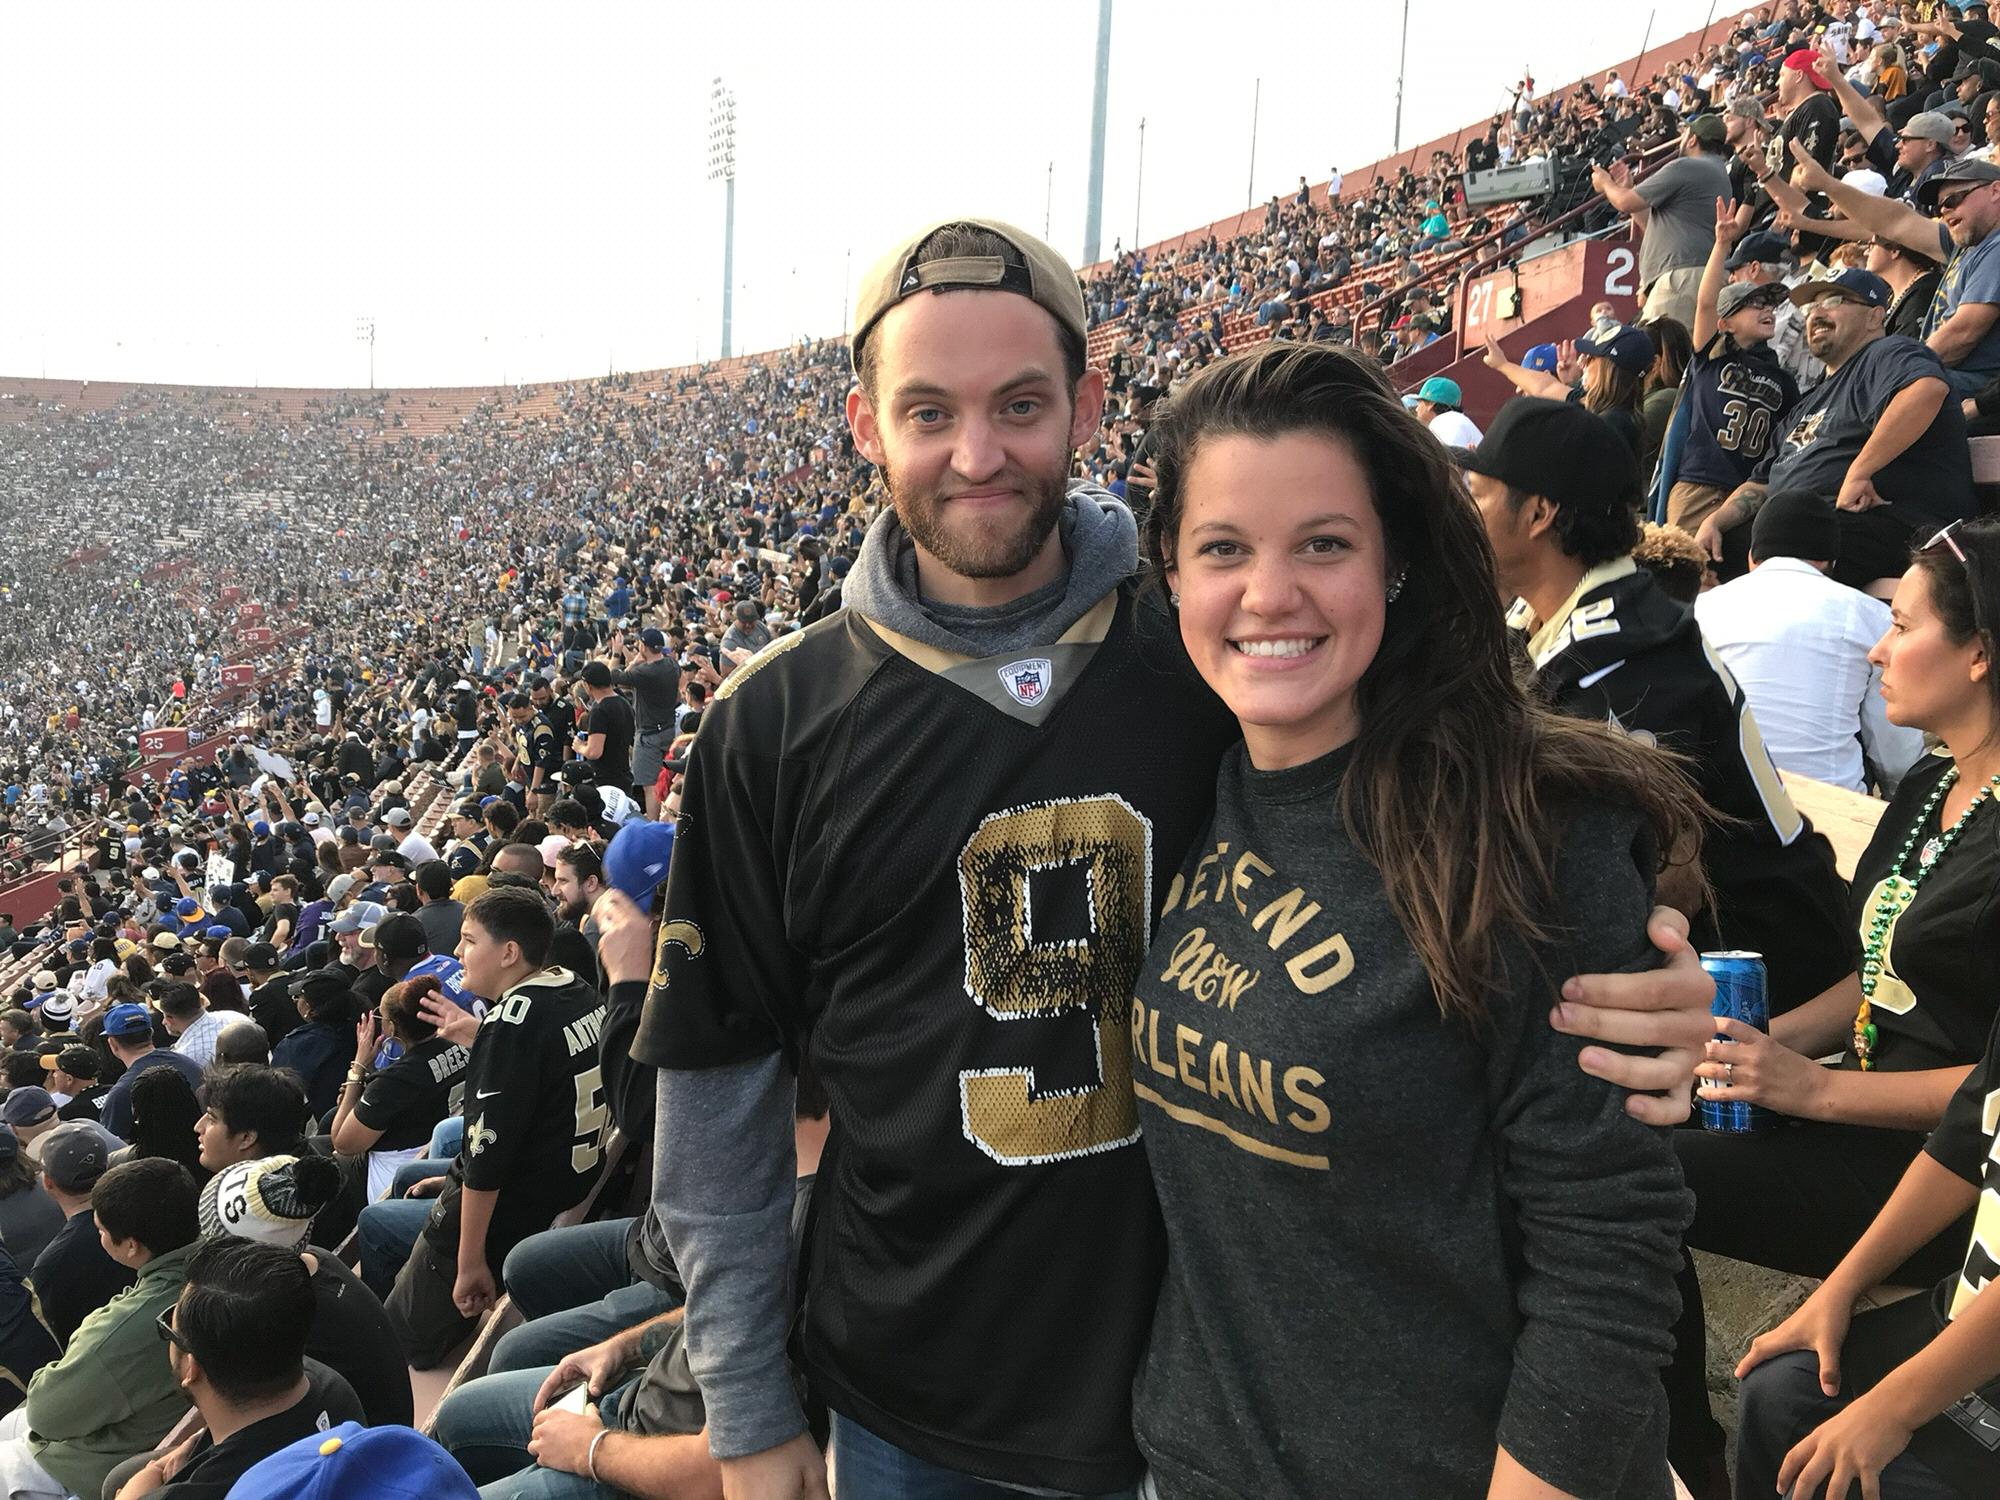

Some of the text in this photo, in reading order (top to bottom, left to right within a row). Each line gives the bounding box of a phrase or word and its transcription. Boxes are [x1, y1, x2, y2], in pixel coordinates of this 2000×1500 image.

[1605, 248, 1635, 296] 2
[1468, 280, 1494, 326] 27
[1717, 400, 1770, 458] 30
[247, 632, 259, 640] 23
[225, 671, 239, 681] 24
[1003, 662, 1047, 678] EQUIPMENT
[1019, 683, 1040, 697] NFL
[144, 738, 164, 750] 25
[958, 791, 1153, 1166] 9
[562, 1004, 608, 1057] ANTHO
[1131, 997, 1331, 1133] RLEANS
[571, 1065, 615, 1174] 5
[225, 1166, 249, 1224] TS
